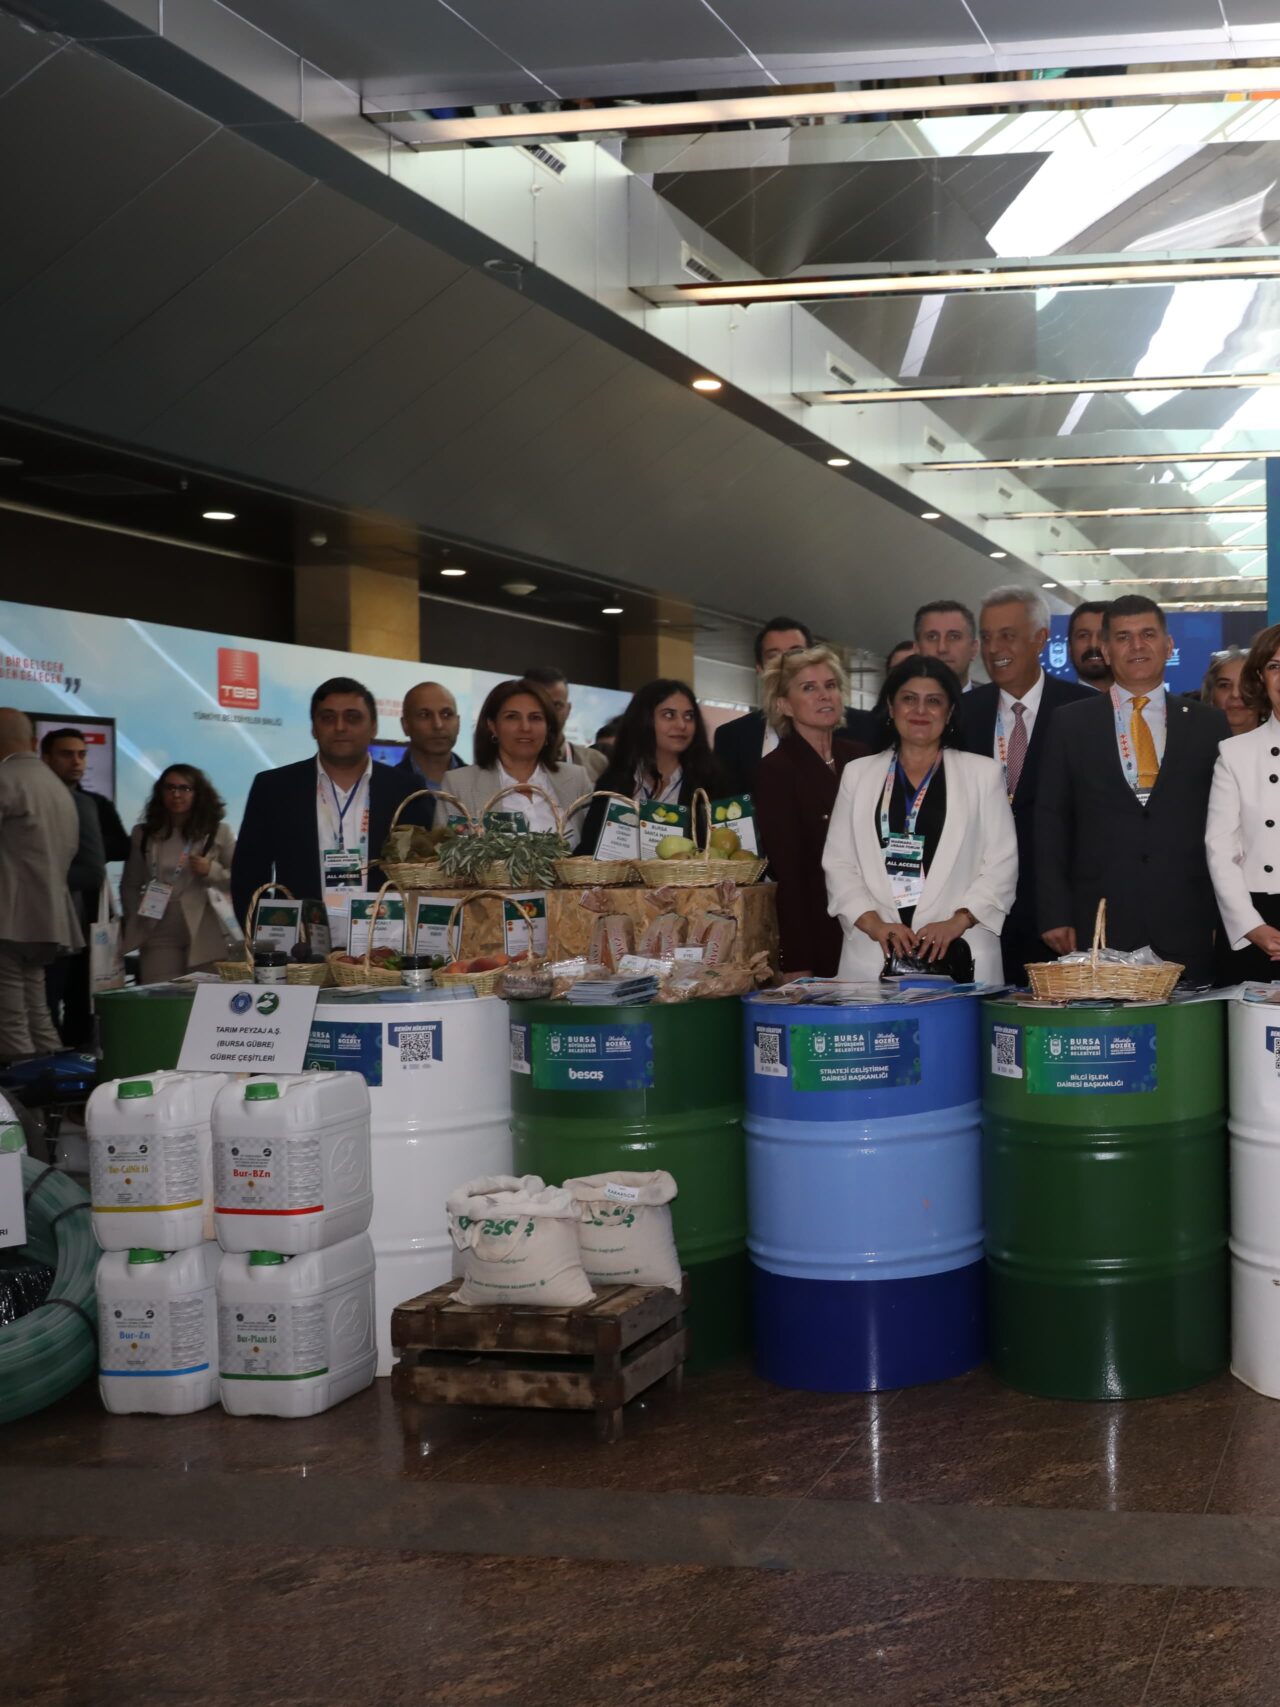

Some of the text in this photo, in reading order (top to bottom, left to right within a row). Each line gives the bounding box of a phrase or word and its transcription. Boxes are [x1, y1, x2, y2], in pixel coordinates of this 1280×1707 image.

[221, 685, 258, 699] TBB
[246, 1040, 274, 1049] GÜBRE)
[238, 1053, 275, 1062] ÇEŞİTLERİ
[850, 1065, 889, 1073] GELİŞTİRME
[569, 1068, 604, 1081] besaş
[821, 1072, 888, 1082] DAİRESİ BAŞKANLIĞI
[1070, 1073, 1109, 1081] BİLGİ İŞLEM
[1056, 1079, 1124, 1089] DAİRESİ BAŞKANLIĞI
[233, 1169, 271, 1179] Bur-BZn
[119, 1331, 151, 1341] Bur-Zn
[237, 1333, 277, 1344] Bur-Plant 16
